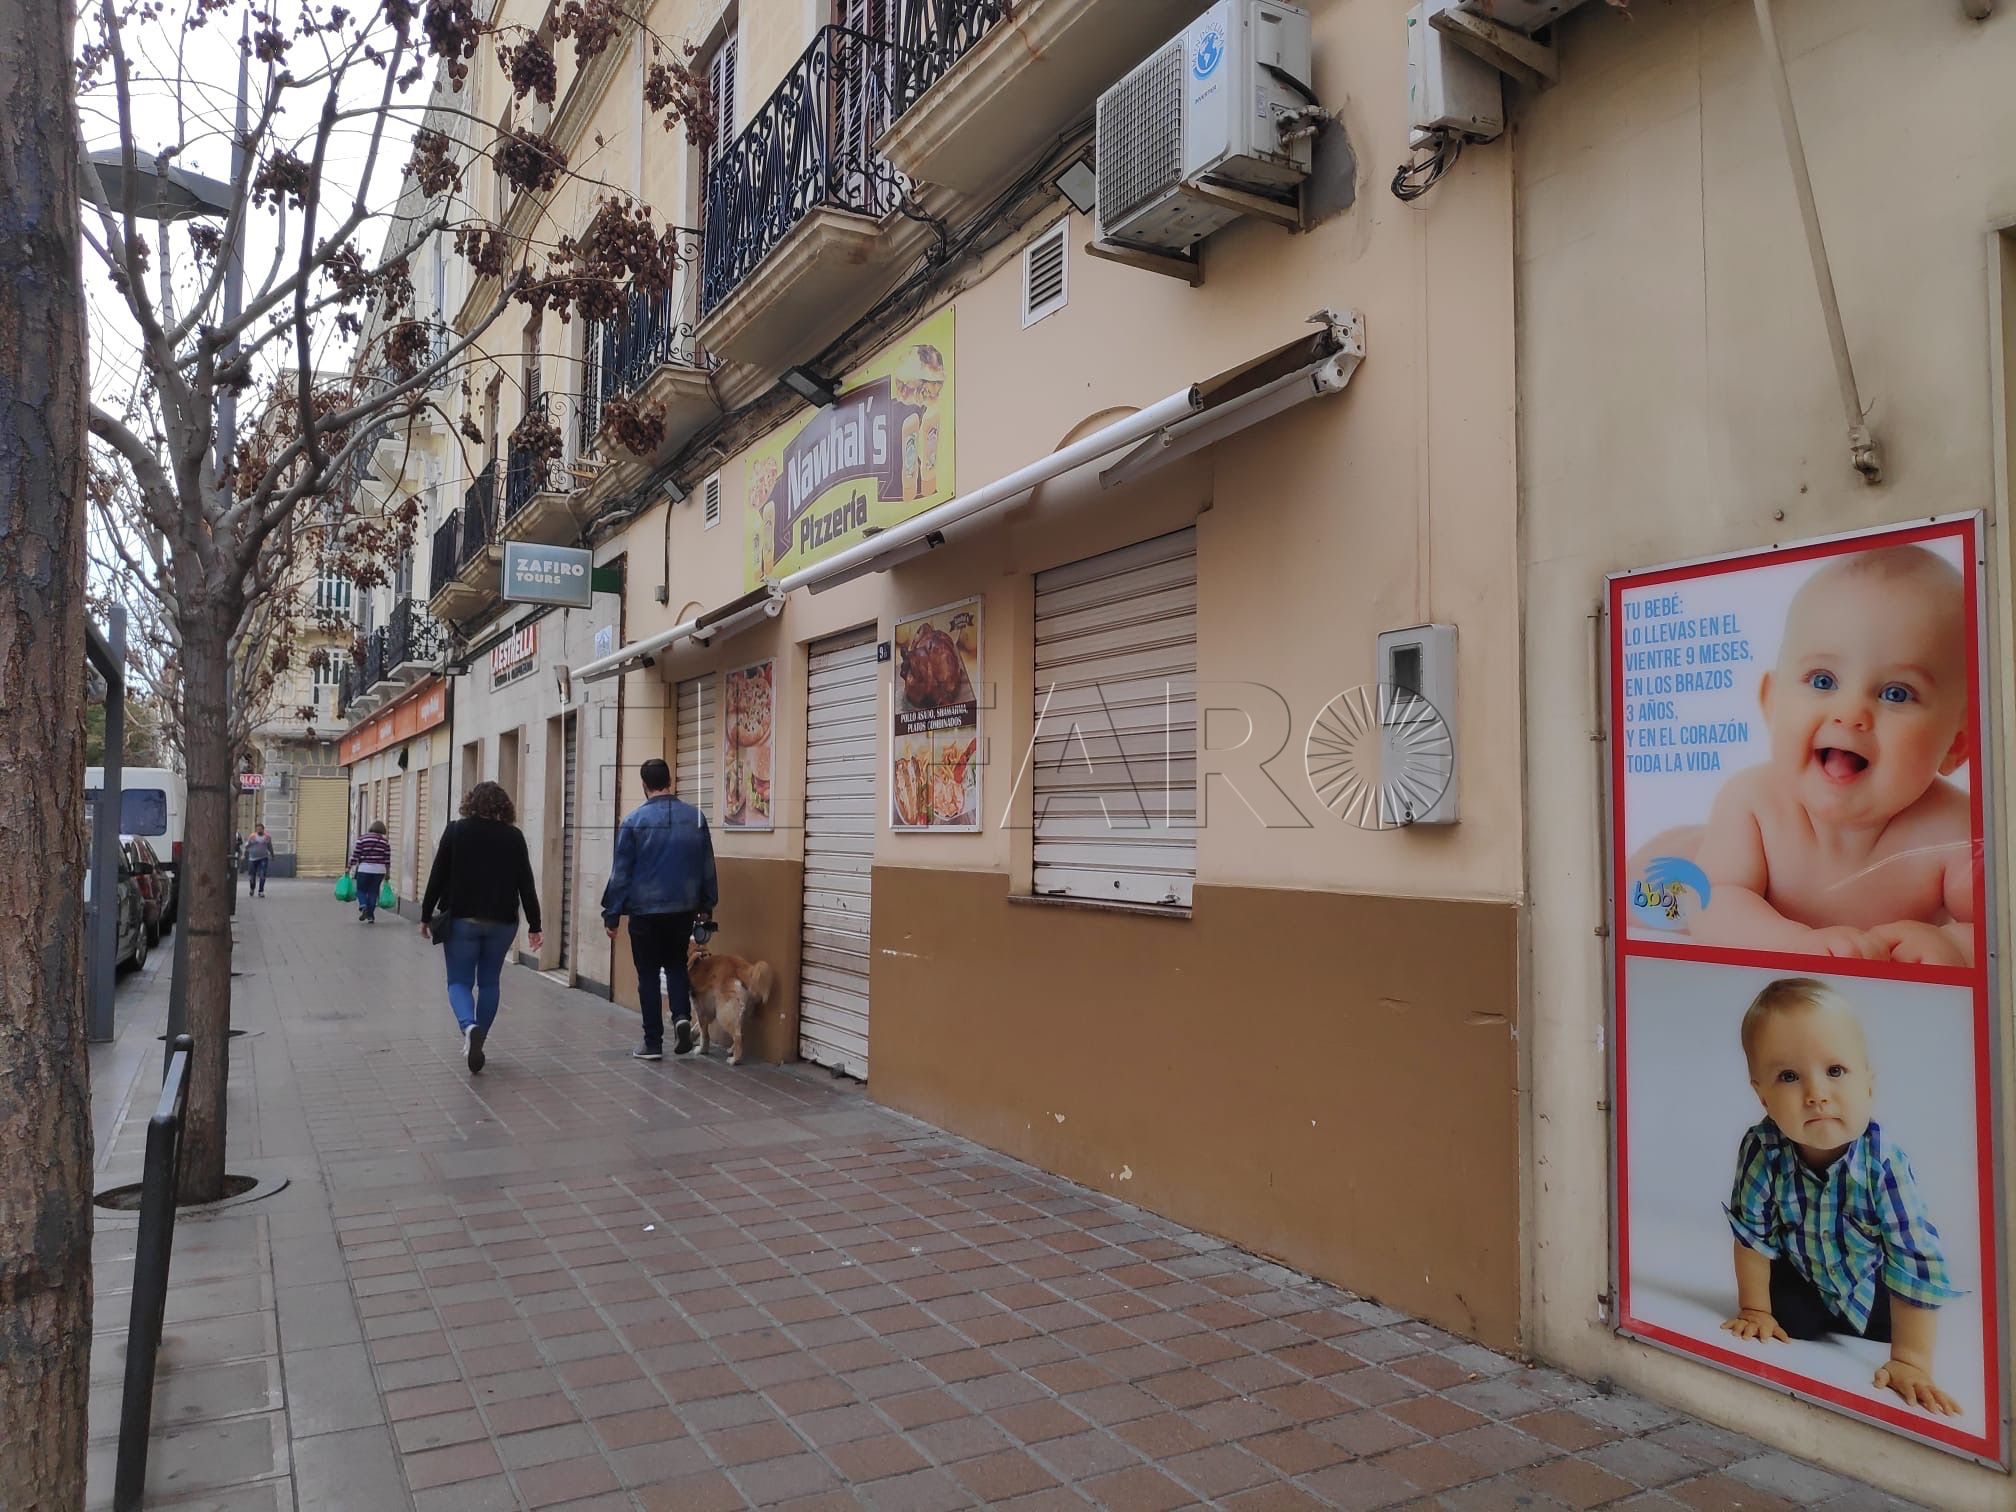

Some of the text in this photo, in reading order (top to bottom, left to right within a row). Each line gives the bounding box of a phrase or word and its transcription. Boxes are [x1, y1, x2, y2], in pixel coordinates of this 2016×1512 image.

[787, 395, 886, 519] Nawhal's
[800, 488, 867, 555] Pizzería
[516, 558, 585, 577] ZAFIRO
[516, 573, 561, 585] TOURS
[1624, 592, 1683, 621] TU BEBÉ:
[1625, 613, 1741, 646] LO LLEVAS EN EL
[1625, 640, 1754, 672] VIENTRE 9 MESES,
[1625, 669, 1733, 697] EN LOS BRAZOS
[900, 712, 917, 723] POLLO
[907, 716, 962, 733] PLATOS COMBINADOS
[1626, 704, 1634, 722] 3
[1626, 718, 1748, 748] Y EN EL CORAZÓN
[1627, 751, 1721, 773] TODA LA VIDA
